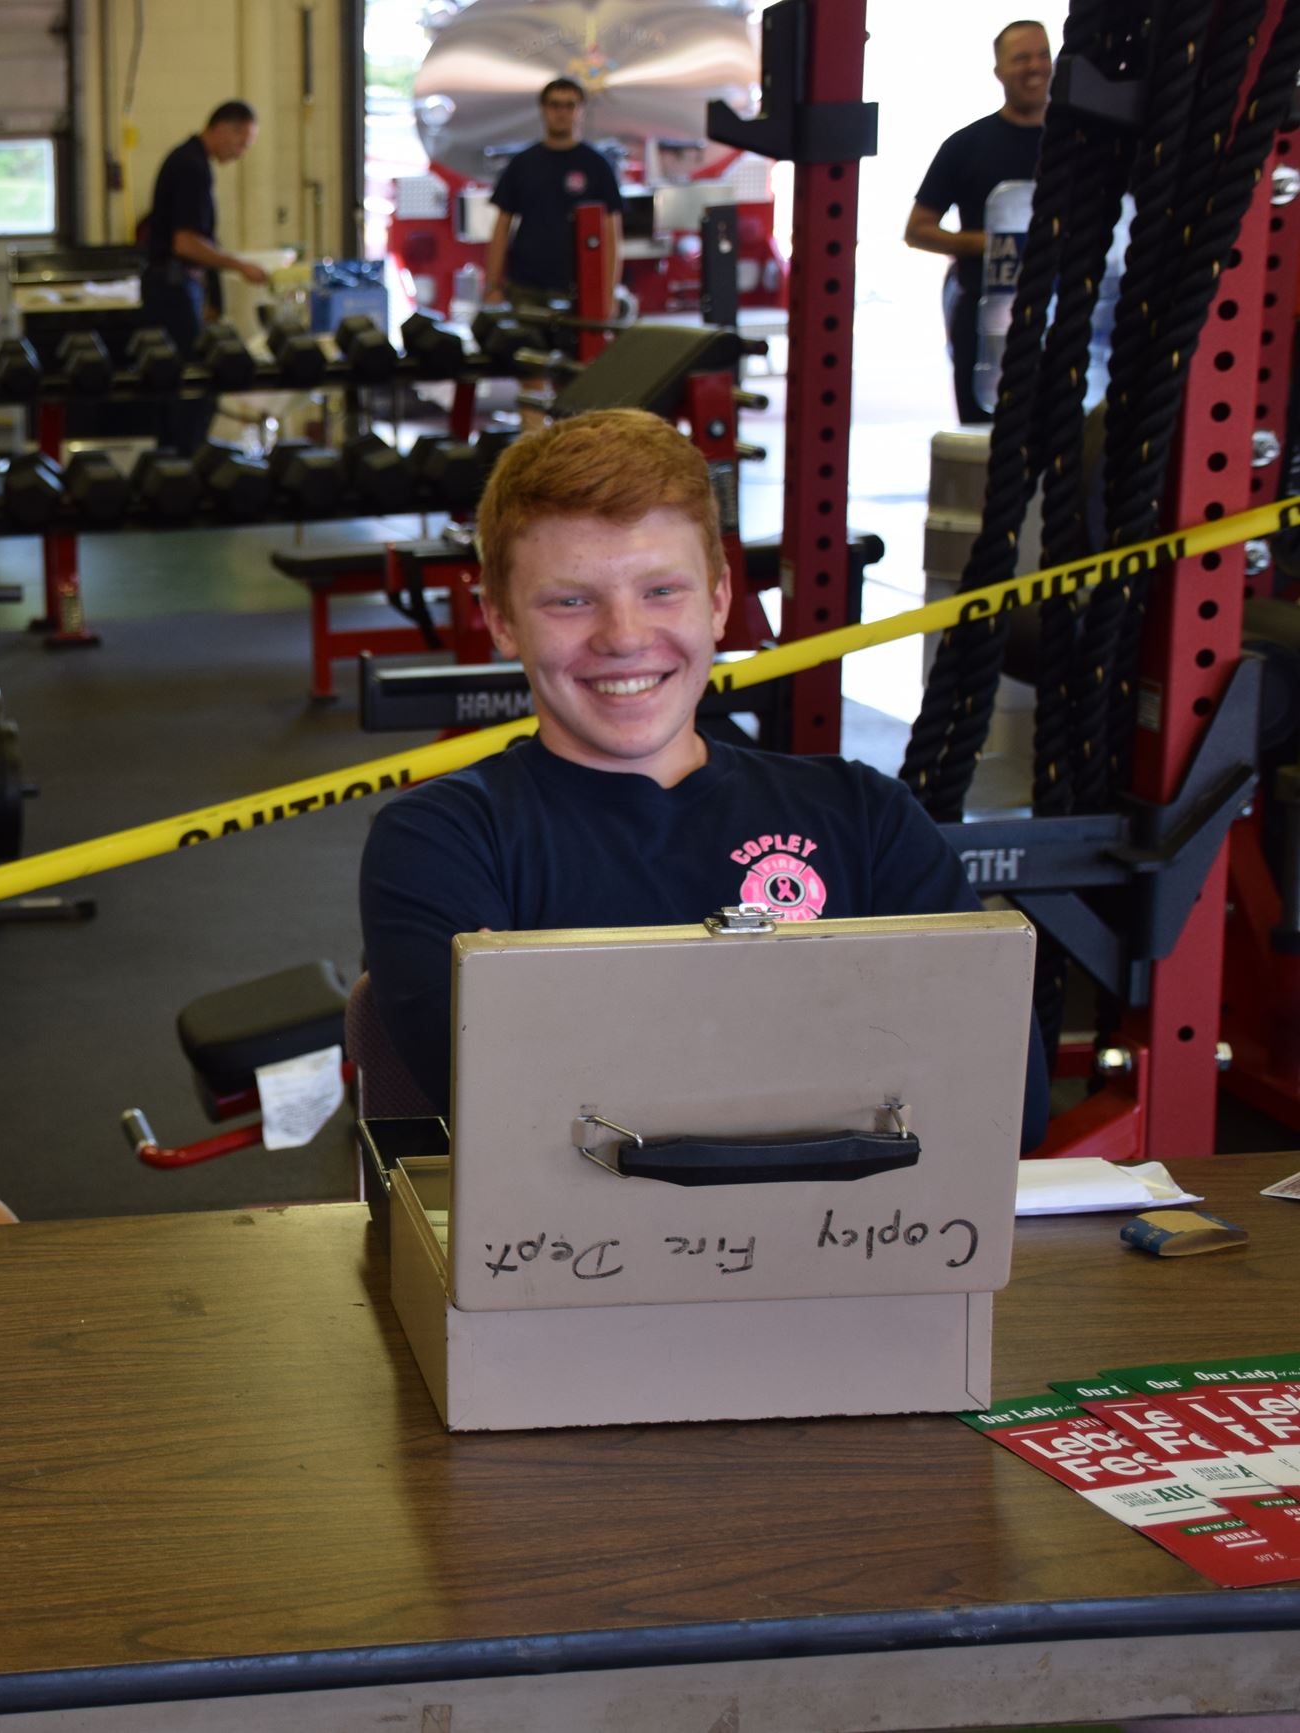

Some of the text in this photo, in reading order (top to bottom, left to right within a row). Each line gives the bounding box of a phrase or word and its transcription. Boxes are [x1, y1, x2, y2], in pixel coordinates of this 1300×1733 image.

[730, 834, 818, 865] COPLEY
[762, 858, 797, 873] FIRE
[817, 1208, 979, 1268] Copley
[665, 1235, 756, 1275] Fire
[1194, 1371, 1230, 1381] Our
[1229, 1369, 1278, 1380] Lady
[1077, 1387, 1111, 1397] Our
[1146, 1379, 1182, 1389] Our
[977, 1411, 1013, 1425] Our
[1010, 1405, 1058, 1420] Lady
